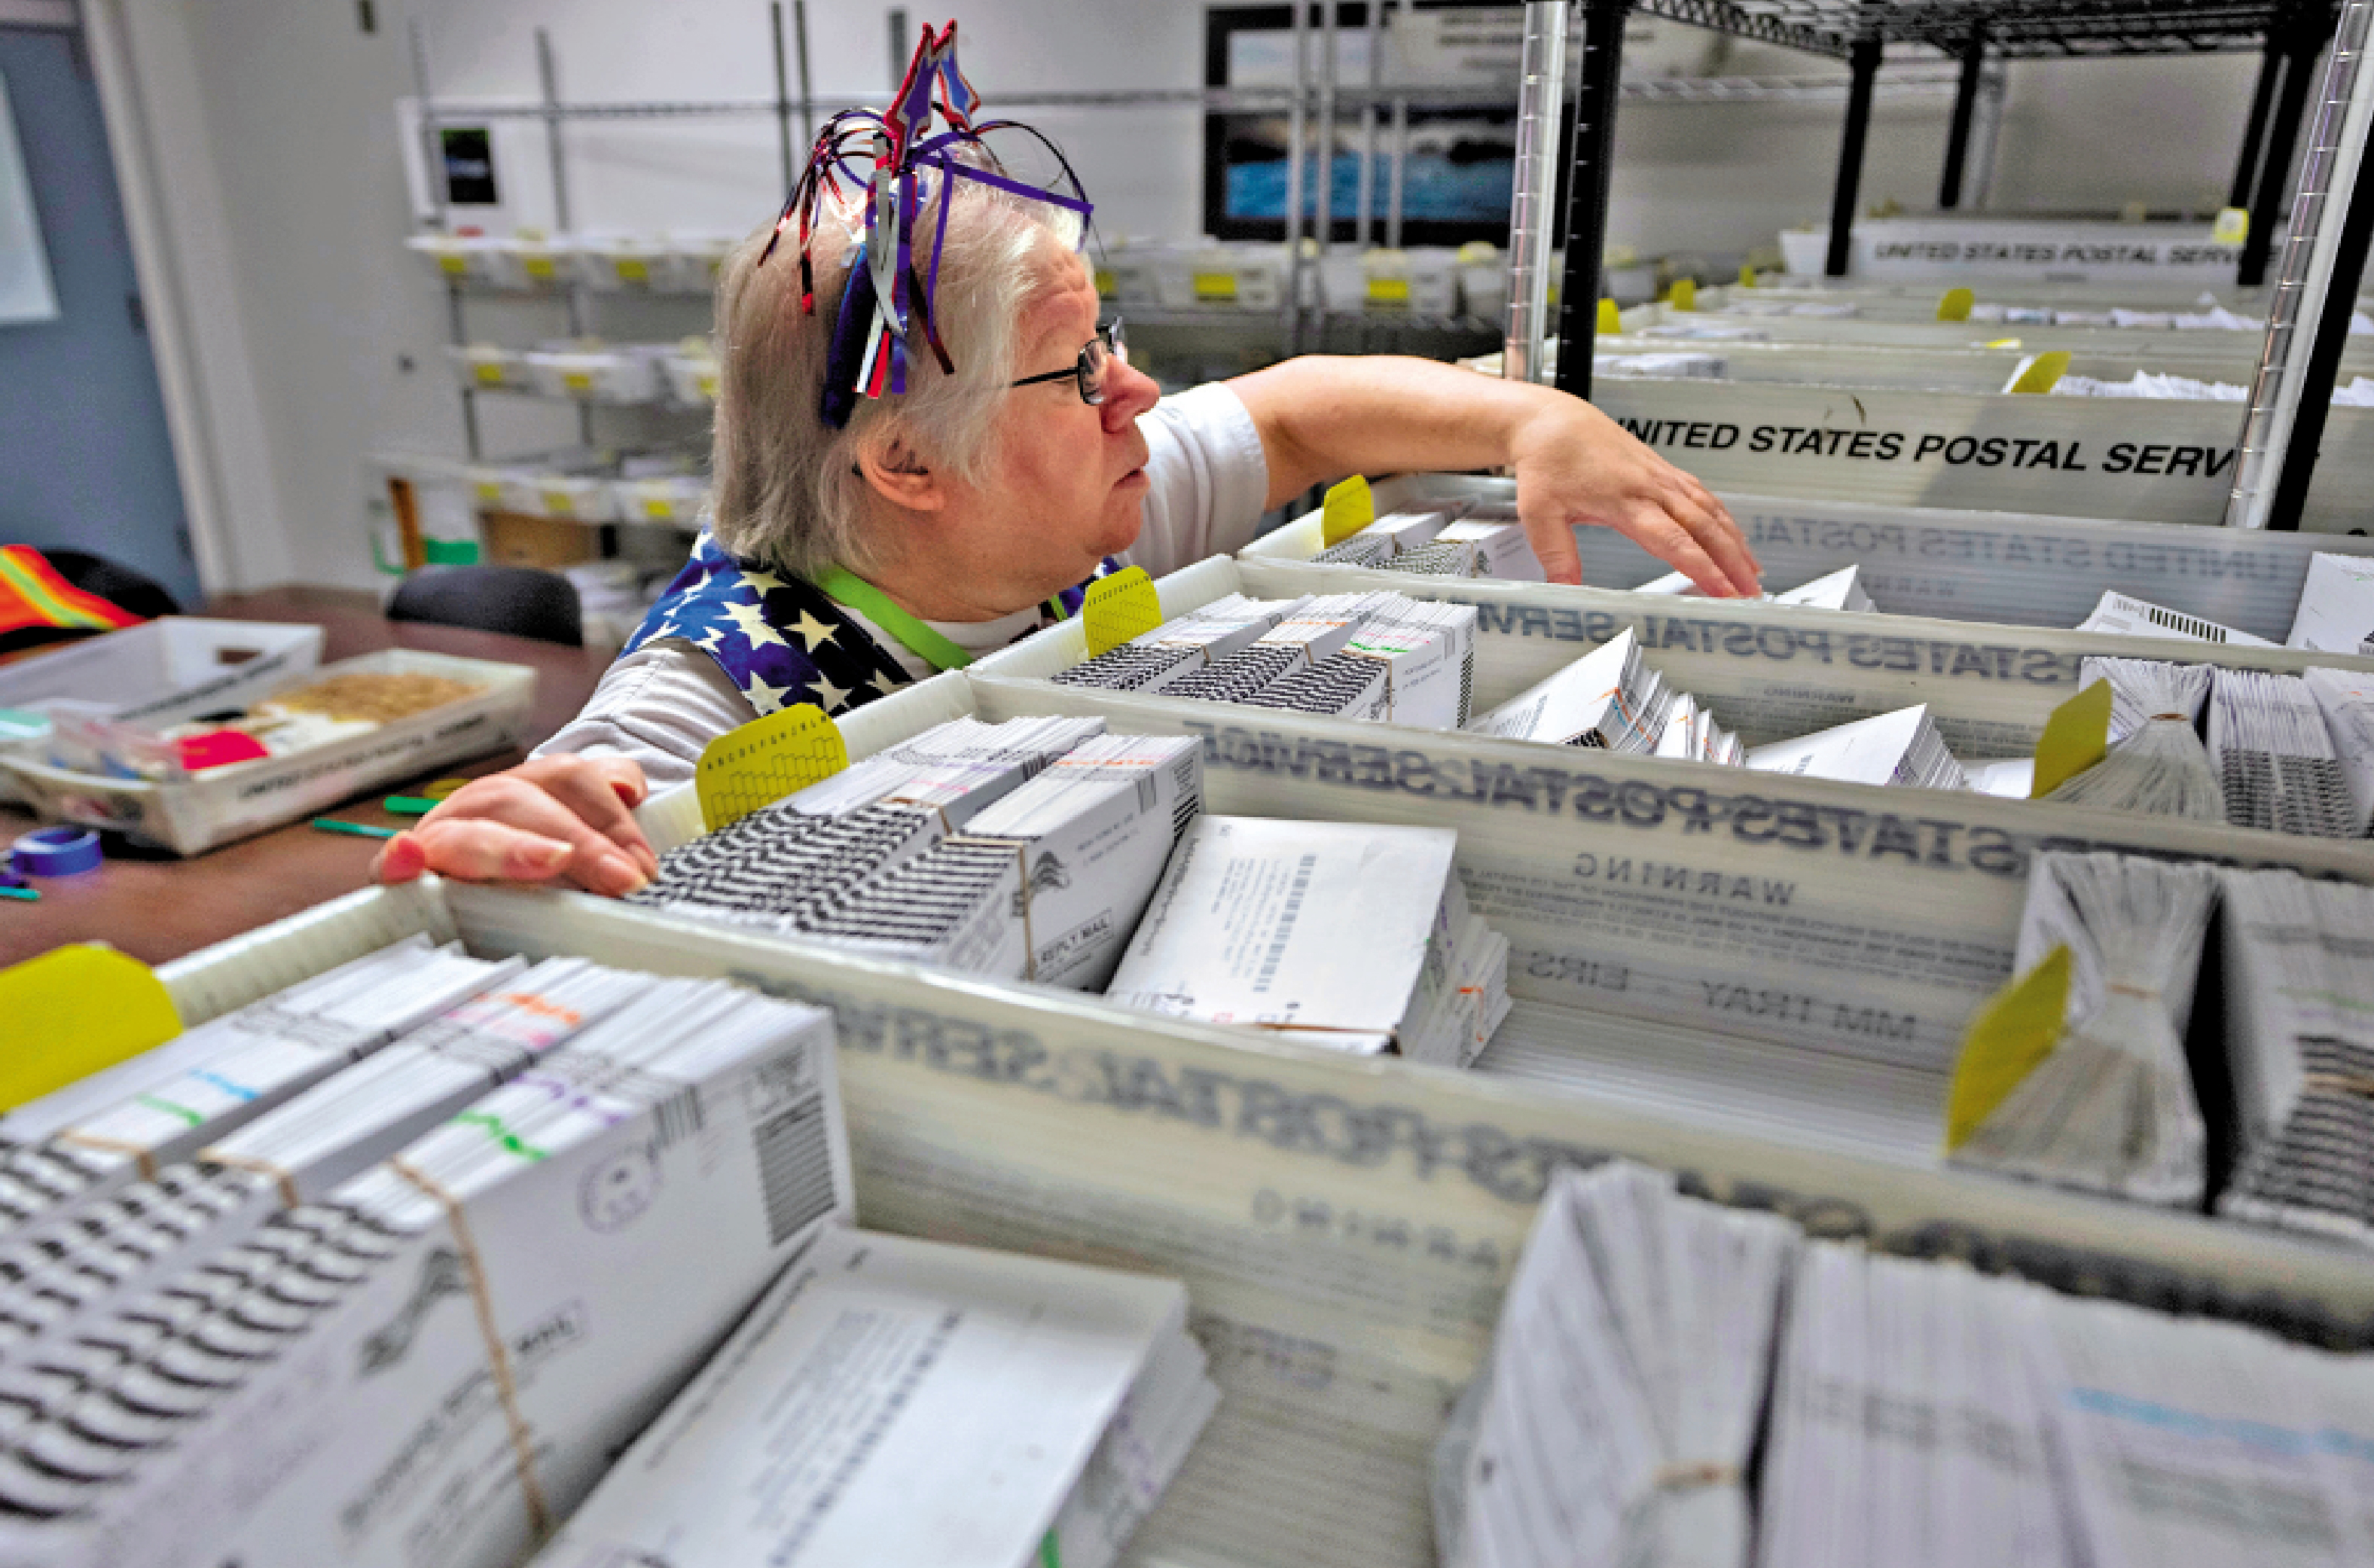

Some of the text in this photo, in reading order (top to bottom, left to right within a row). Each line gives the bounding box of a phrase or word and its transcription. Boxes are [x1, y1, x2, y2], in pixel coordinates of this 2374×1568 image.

[1618, 417, 2234, 478] NITED STATES POSTAL SERV
